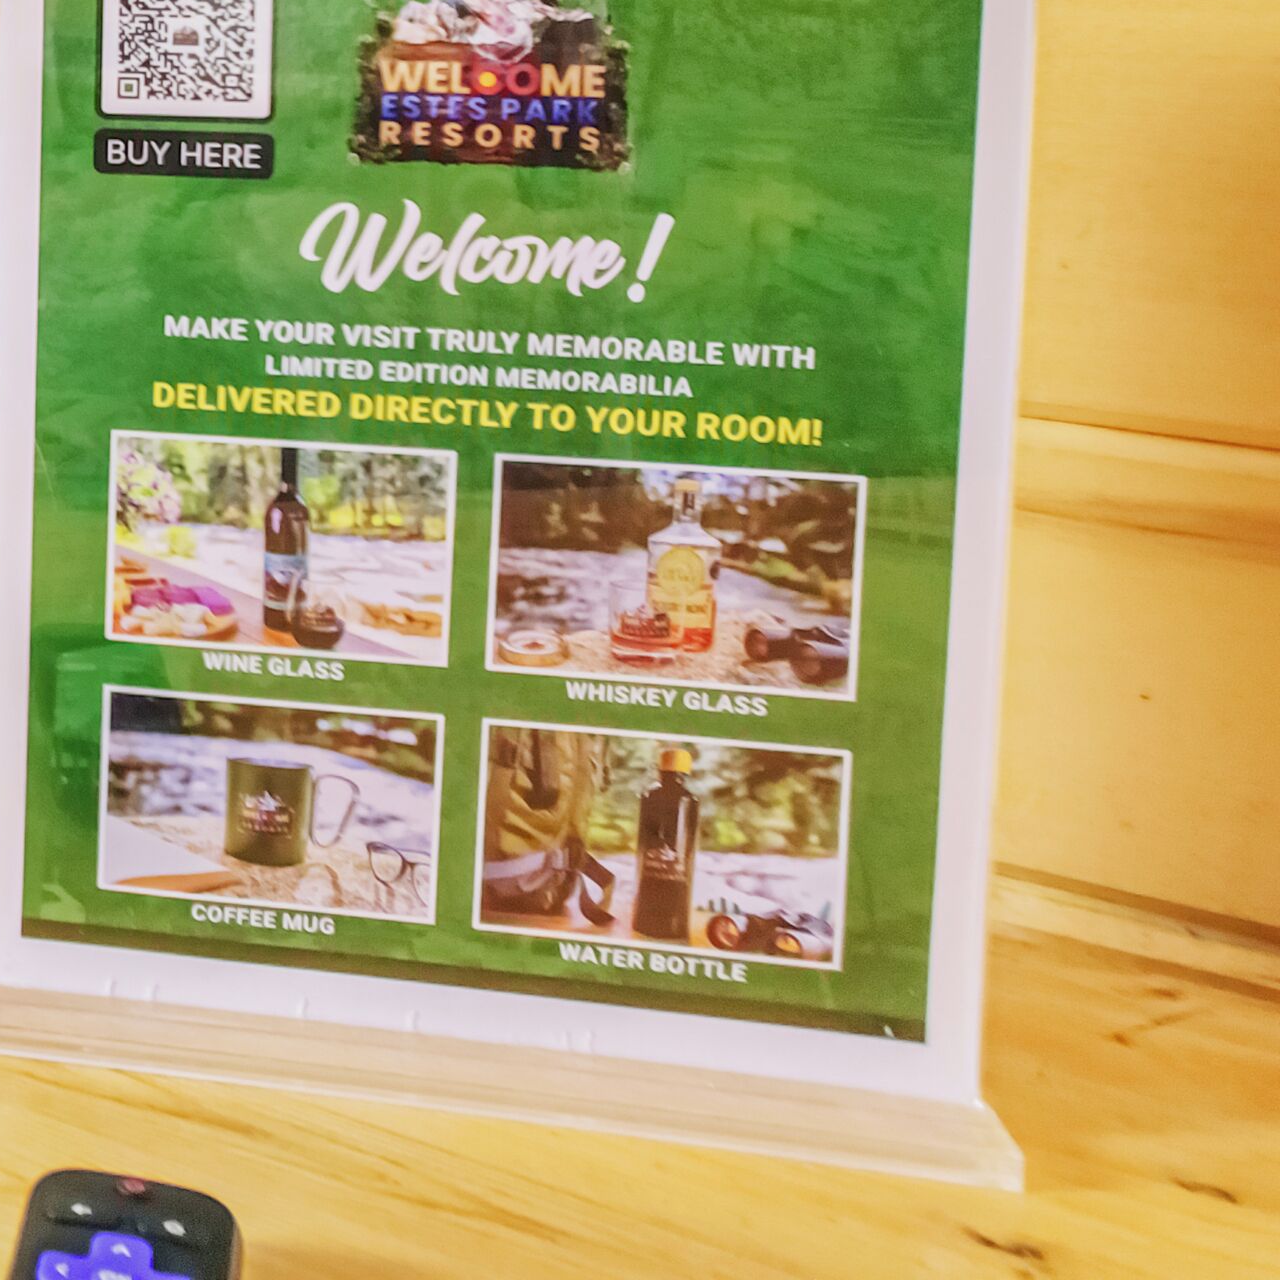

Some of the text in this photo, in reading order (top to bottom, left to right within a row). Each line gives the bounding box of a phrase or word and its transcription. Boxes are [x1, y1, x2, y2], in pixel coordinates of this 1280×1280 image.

[380, 60, 606, 98] WELCOME
[381, 94, 598, 124] ESTES PARK
[107, 138, 263, 169] BUY HERE
[379, 120, 601, 152] RESORTS
[164, 315, 816, 370] MAKE YOUR VISIT TRULY MEMORABLE WITH
[265, 355, 694, 398] LIMITED EDITION MEMORABILIA
[152, 381, 824, 447] DELIVERED DIRECTLY TO YOUR ROOM!
[202, 652, 346, 681] WINE GLASS
[565, 680, 769, 717] WHISKEY GLASS
[191, 903, 336, 936] COFFEE MUG
[558, 941, 749, 984] WATER BOTTLE
